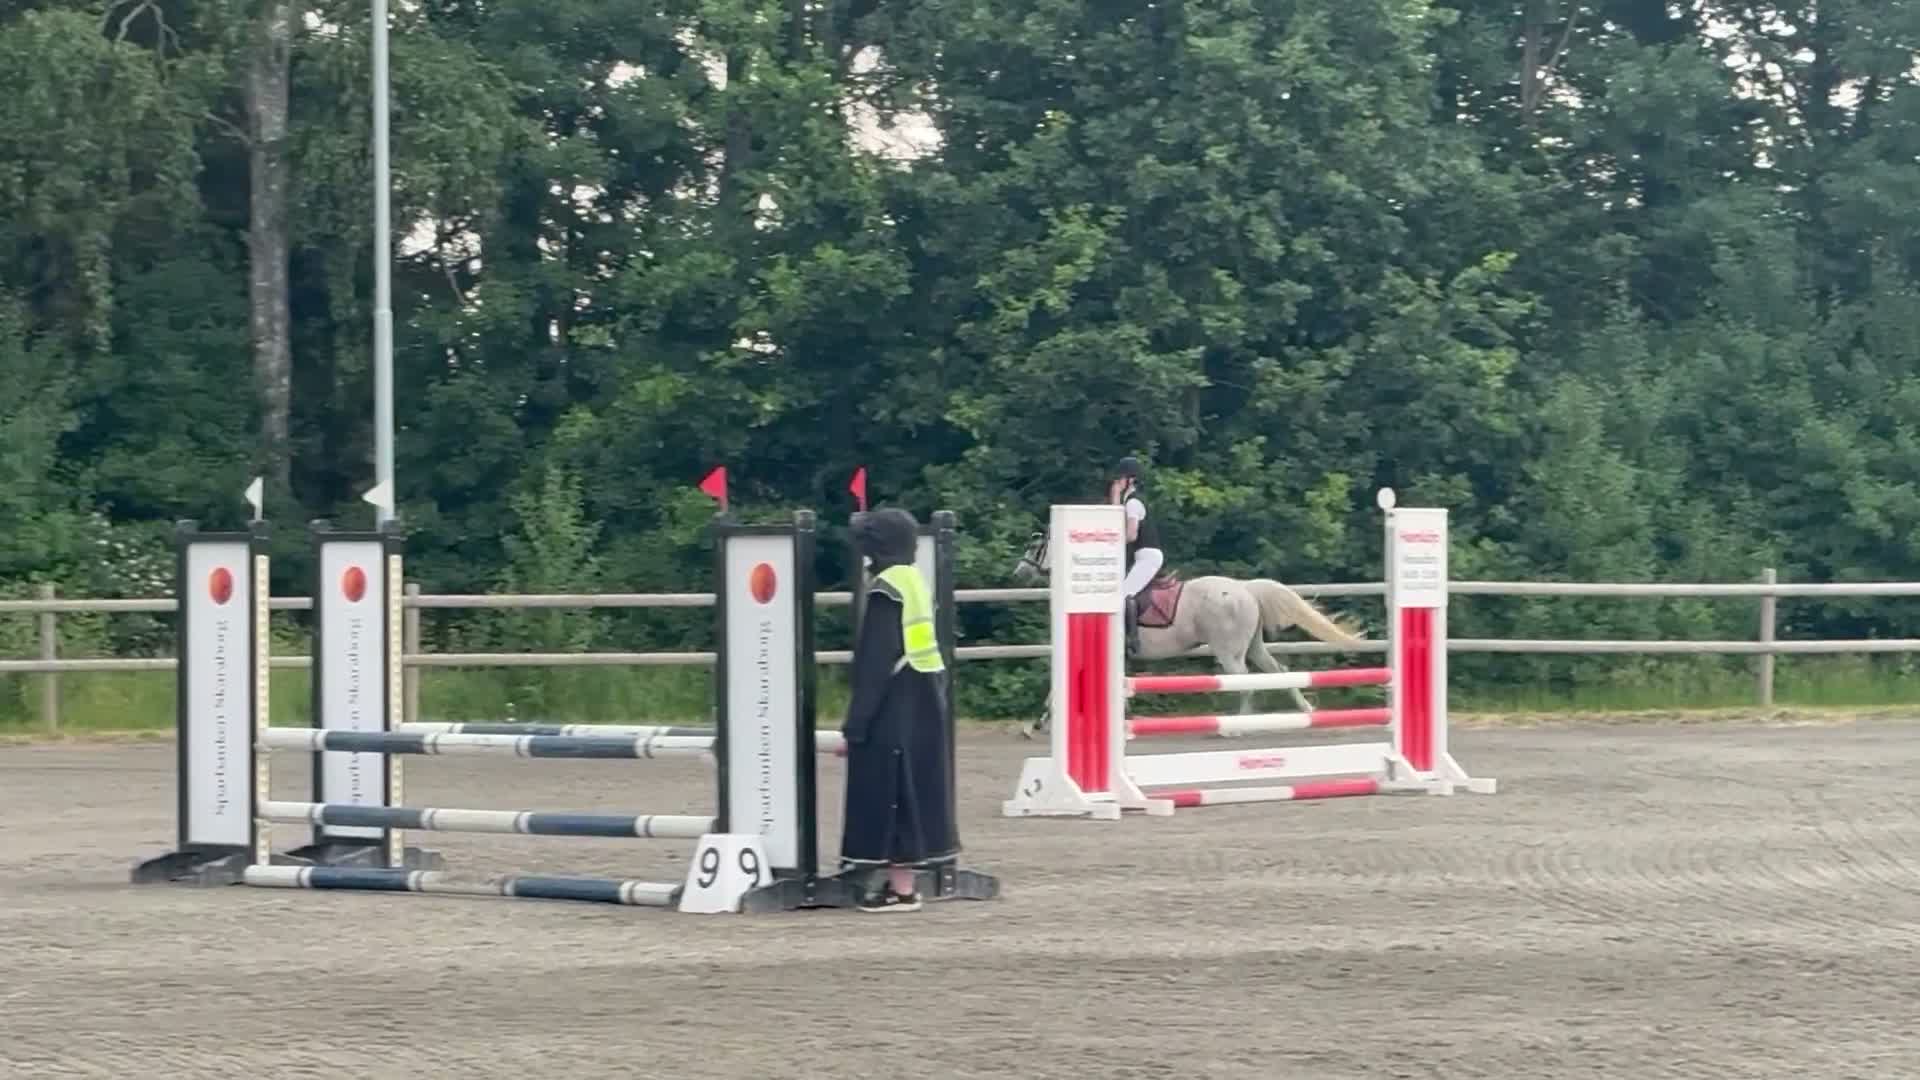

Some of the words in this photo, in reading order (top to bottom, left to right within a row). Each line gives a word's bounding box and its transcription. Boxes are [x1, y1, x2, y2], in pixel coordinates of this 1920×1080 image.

[757, 725, 774, 835] Sparbanken
[697, 847, 720, 889] 9
[739, 847, 760, 888] 9
